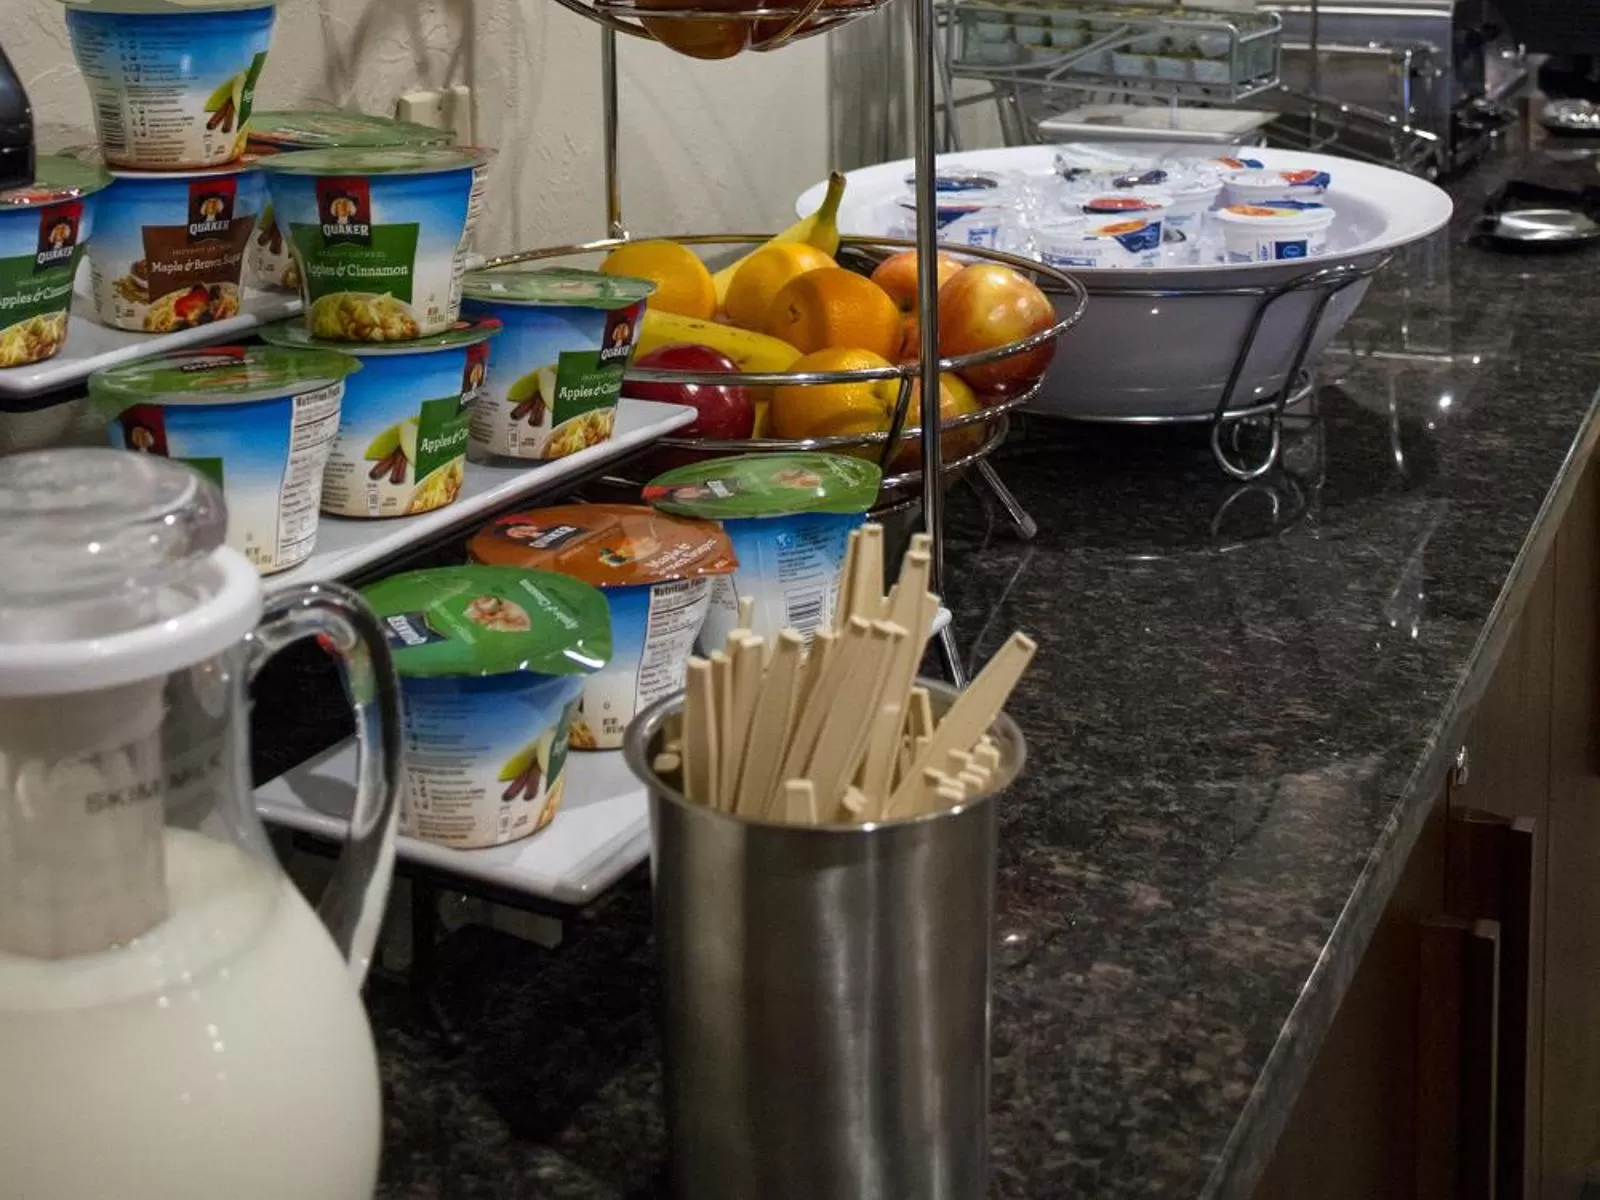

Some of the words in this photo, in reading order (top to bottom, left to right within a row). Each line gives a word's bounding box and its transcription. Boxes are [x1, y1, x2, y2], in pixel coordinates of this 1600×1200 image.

[189, 220, 230, 236] QUAKER
[322, 223, 369, 237] QUAKER
[151, 261, 183, 275] Maple
[347, 263, 408, 277] Cinnamon
[0, 291, 33, 310] pples
[558, 385, 595, 400] Apples
[420, 432, 452, 453] Apples
[653, 580, 689, 597] Nutrition
